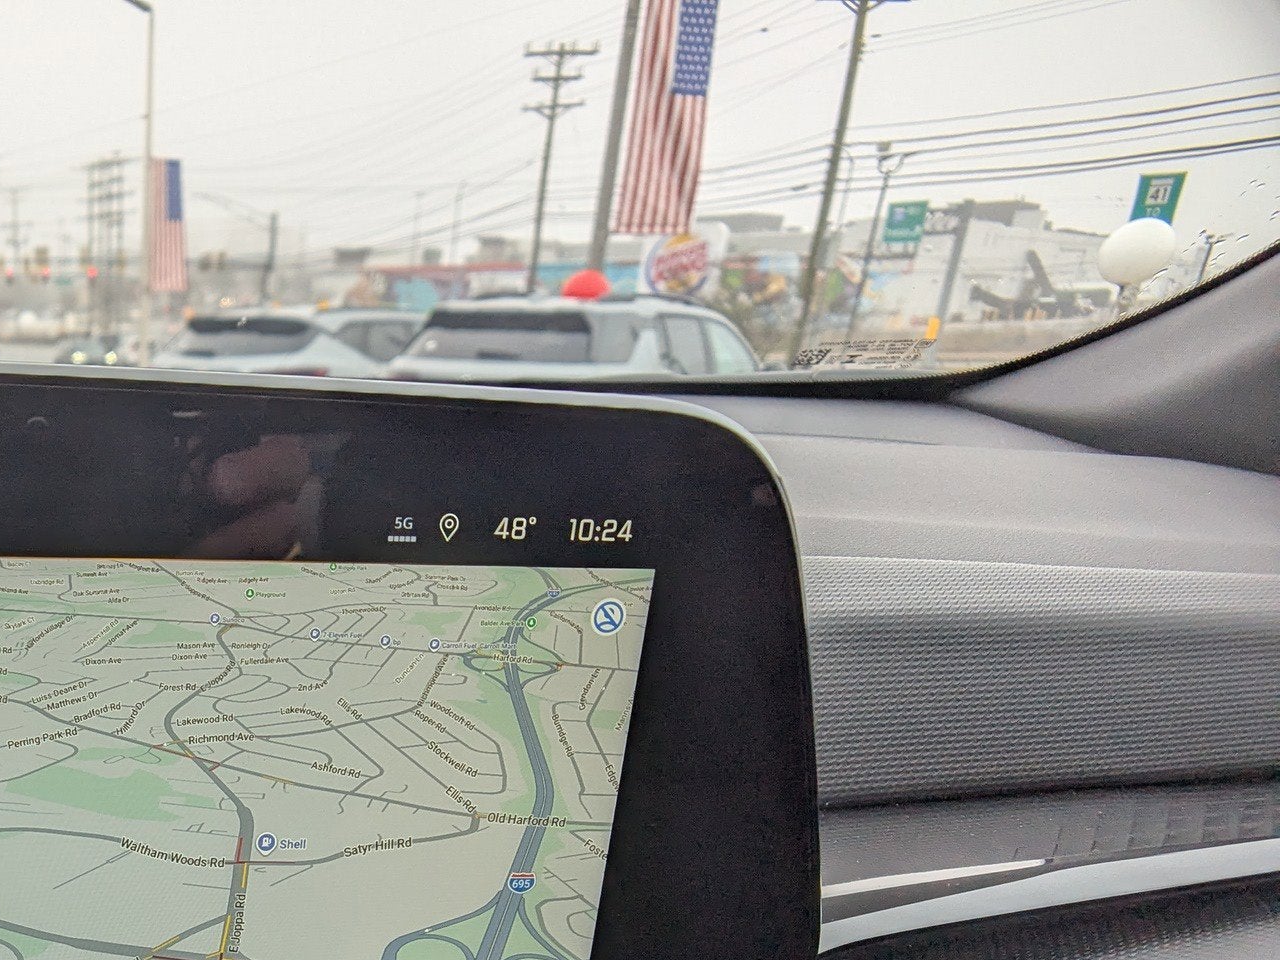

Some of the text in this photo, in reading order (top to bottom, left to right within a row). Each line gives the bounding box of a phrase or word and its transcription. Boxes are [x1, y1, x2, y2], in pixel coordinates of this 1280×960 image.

[1149, 187, 1168, 201] 41
[395, 517, 413, 529] 5G
[494, 516, 536, 540] 48°
[570, 519, 632, 542] 10:24
[82, 632, 101, 649] Aspen
[109, 619, 119, 628] Rd
[323, 631, 347, 639] 7-Eleven
[3, 646, 13, 654] Rd
[200, 641, 215, 649] Ave
[85, 658, 107, 666] Dixon
[171, 652, 208, 661] Dixon Ave
[240, 656, 290, 666] Fullerdale Ave
[493, 653, 533, 664] Harford Rd
[395, 653, 425, 684] Duncan Ln
[32, 680, 88, 704] Luiss Deane Dr
[159, 683, 197, 691] Forest Rd
[297, 679, 328, 692] 2nd Ave
[417, 670, 440, 707] Richmond
[47, 690, 99, 711] Matthews Dr
[336, 697, 362, 721] Ellis Rd
[73, 703, 121, 723] Bradford Rd
[116, 700, 147, 736] Hillford Dr
[176, 714, 234, 726] Lakewood Rd
[280, 707, 332, 727] Lakewood Rd
[414, 710, 446, 733] Roper Rd
[430, 700, 475, 731] Woodcroft Rd
[7, 727, 78, 749] Perring Park Rd
[188, 733, 255, 745] Richmond Ave
[551, 714, 574, 758] Burridge Rd
[427, 740, 478, 778] Stockwell Rd
[311, 761, 361, 779] Ashford Rd
[445, 785, 476, 814] Ellis Rd
[487, 812, 567, 828] Old Harford Rd
[120, 837, 225, 868] Waltham Woods Rd
[280, 839, 306, 850] Shell
[343, 837, 412, 858] Satyr Hill Rd
[512, 879, 531, 889] 695
[229, 894, 246, 953] E Joppa Rd
